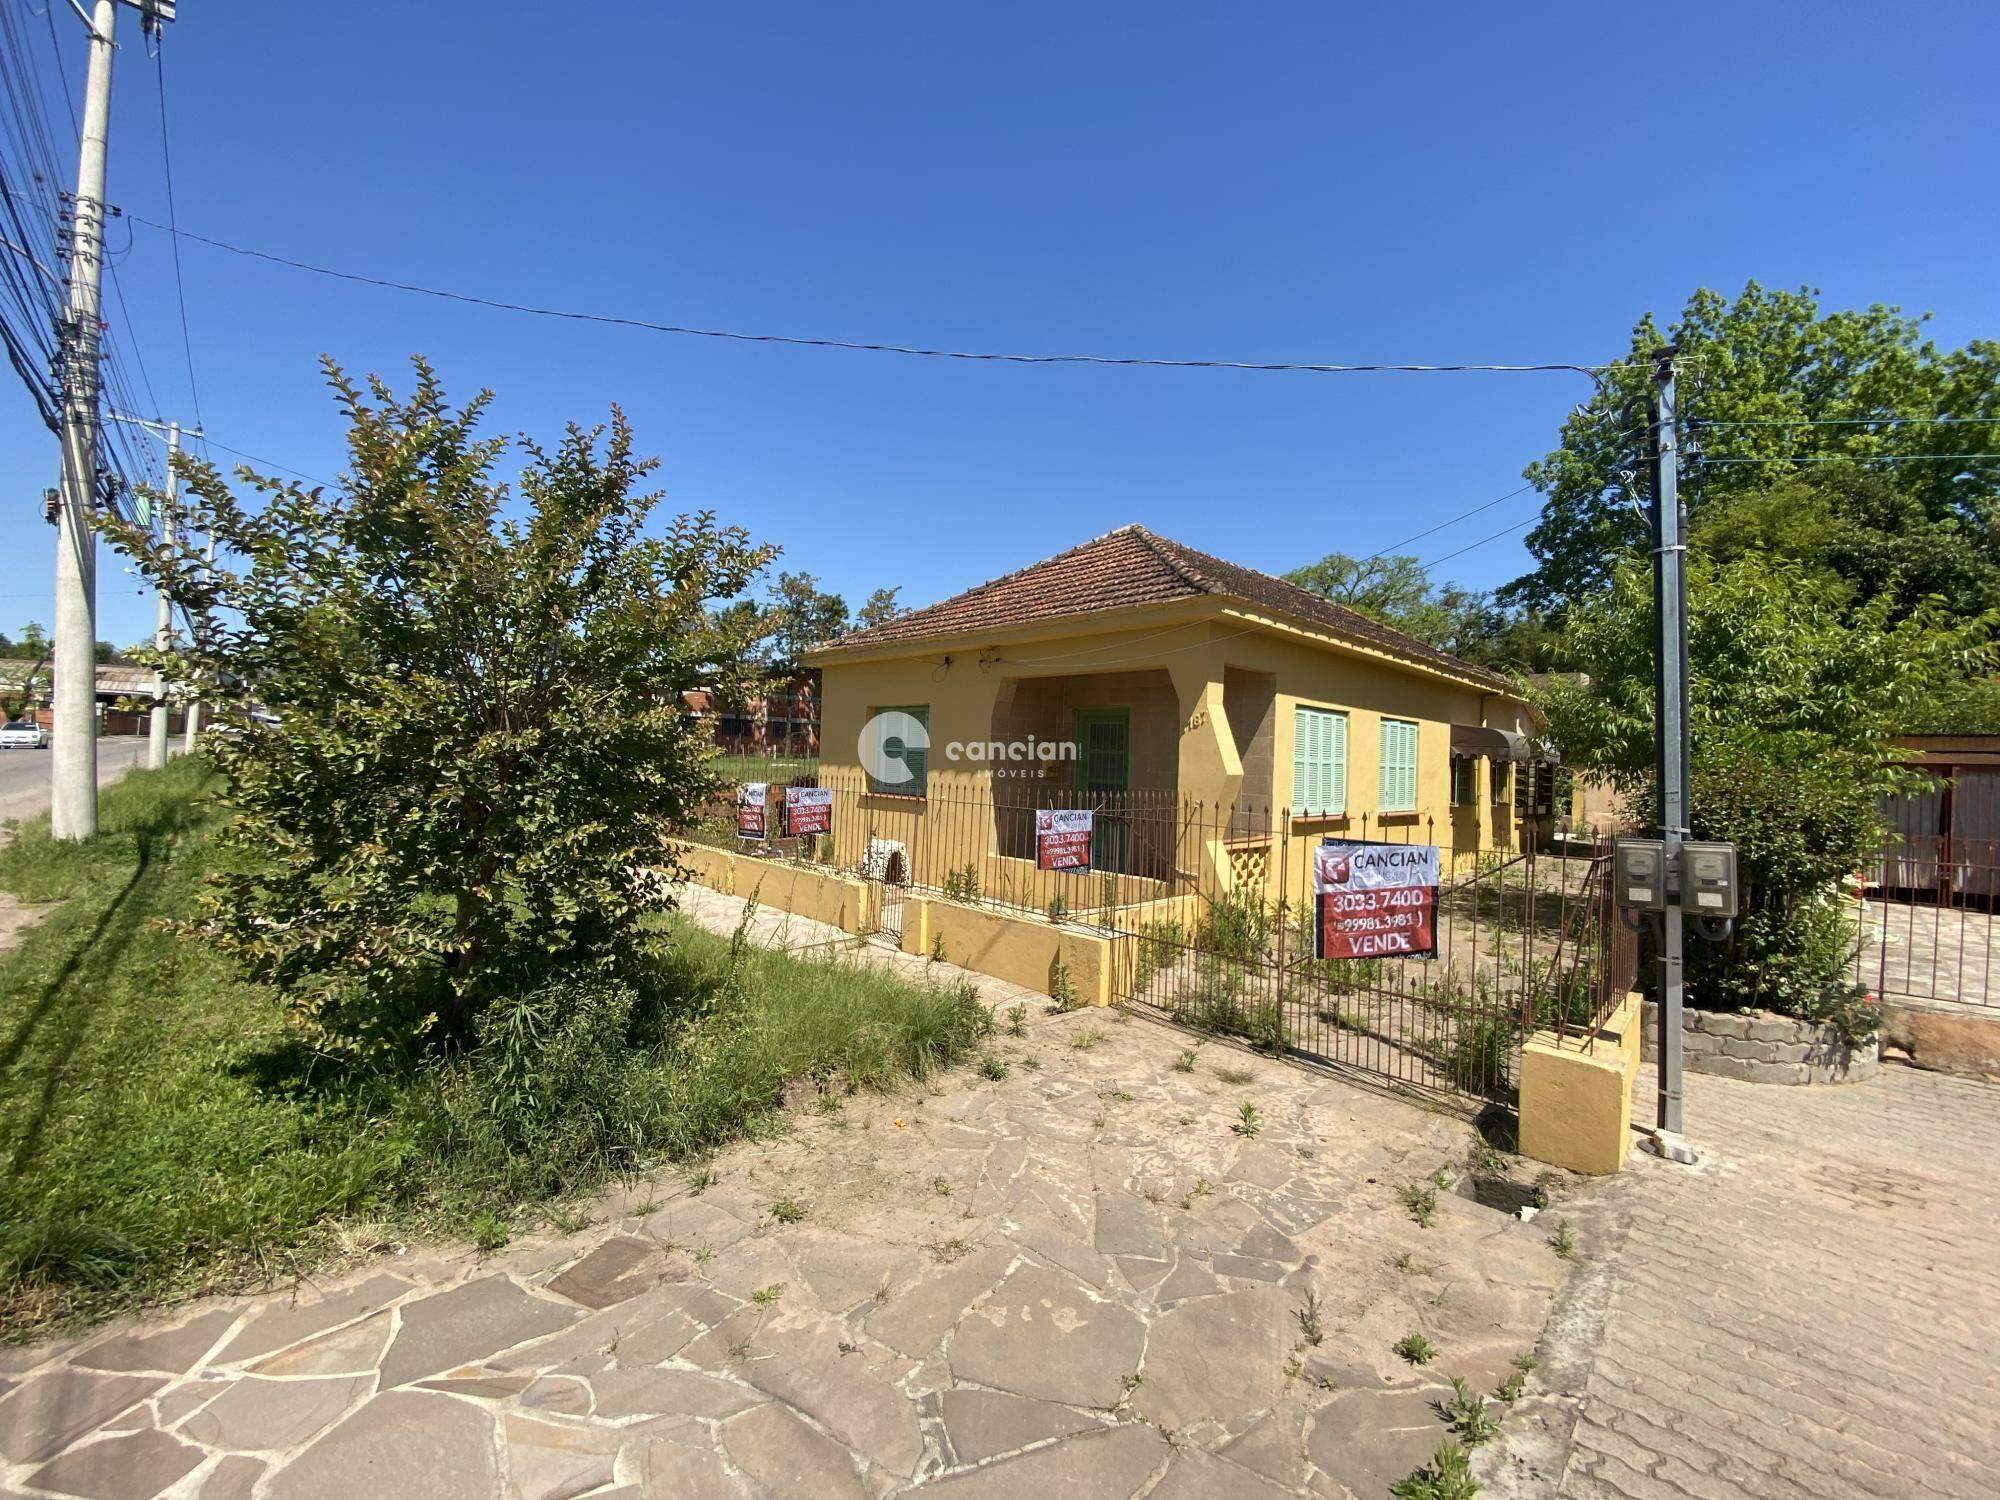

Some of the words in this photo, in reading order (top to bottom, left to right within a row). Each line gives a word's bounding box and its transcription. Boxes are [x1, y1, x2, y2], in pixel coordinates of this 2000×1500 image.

[800, 790, 829, 798] CANCIAN
[1053, 812, 1087, 823] CANCIAN
[1044, 833, 1085, 845] 3033.7400
[1051, 855, 1080, 867] VENDE
[1354, 851, 1428, 869] CANCIAN
[1333, 889, 1424, 913] 3033.7400
[1348, 932, 1411, 954] VENDE
